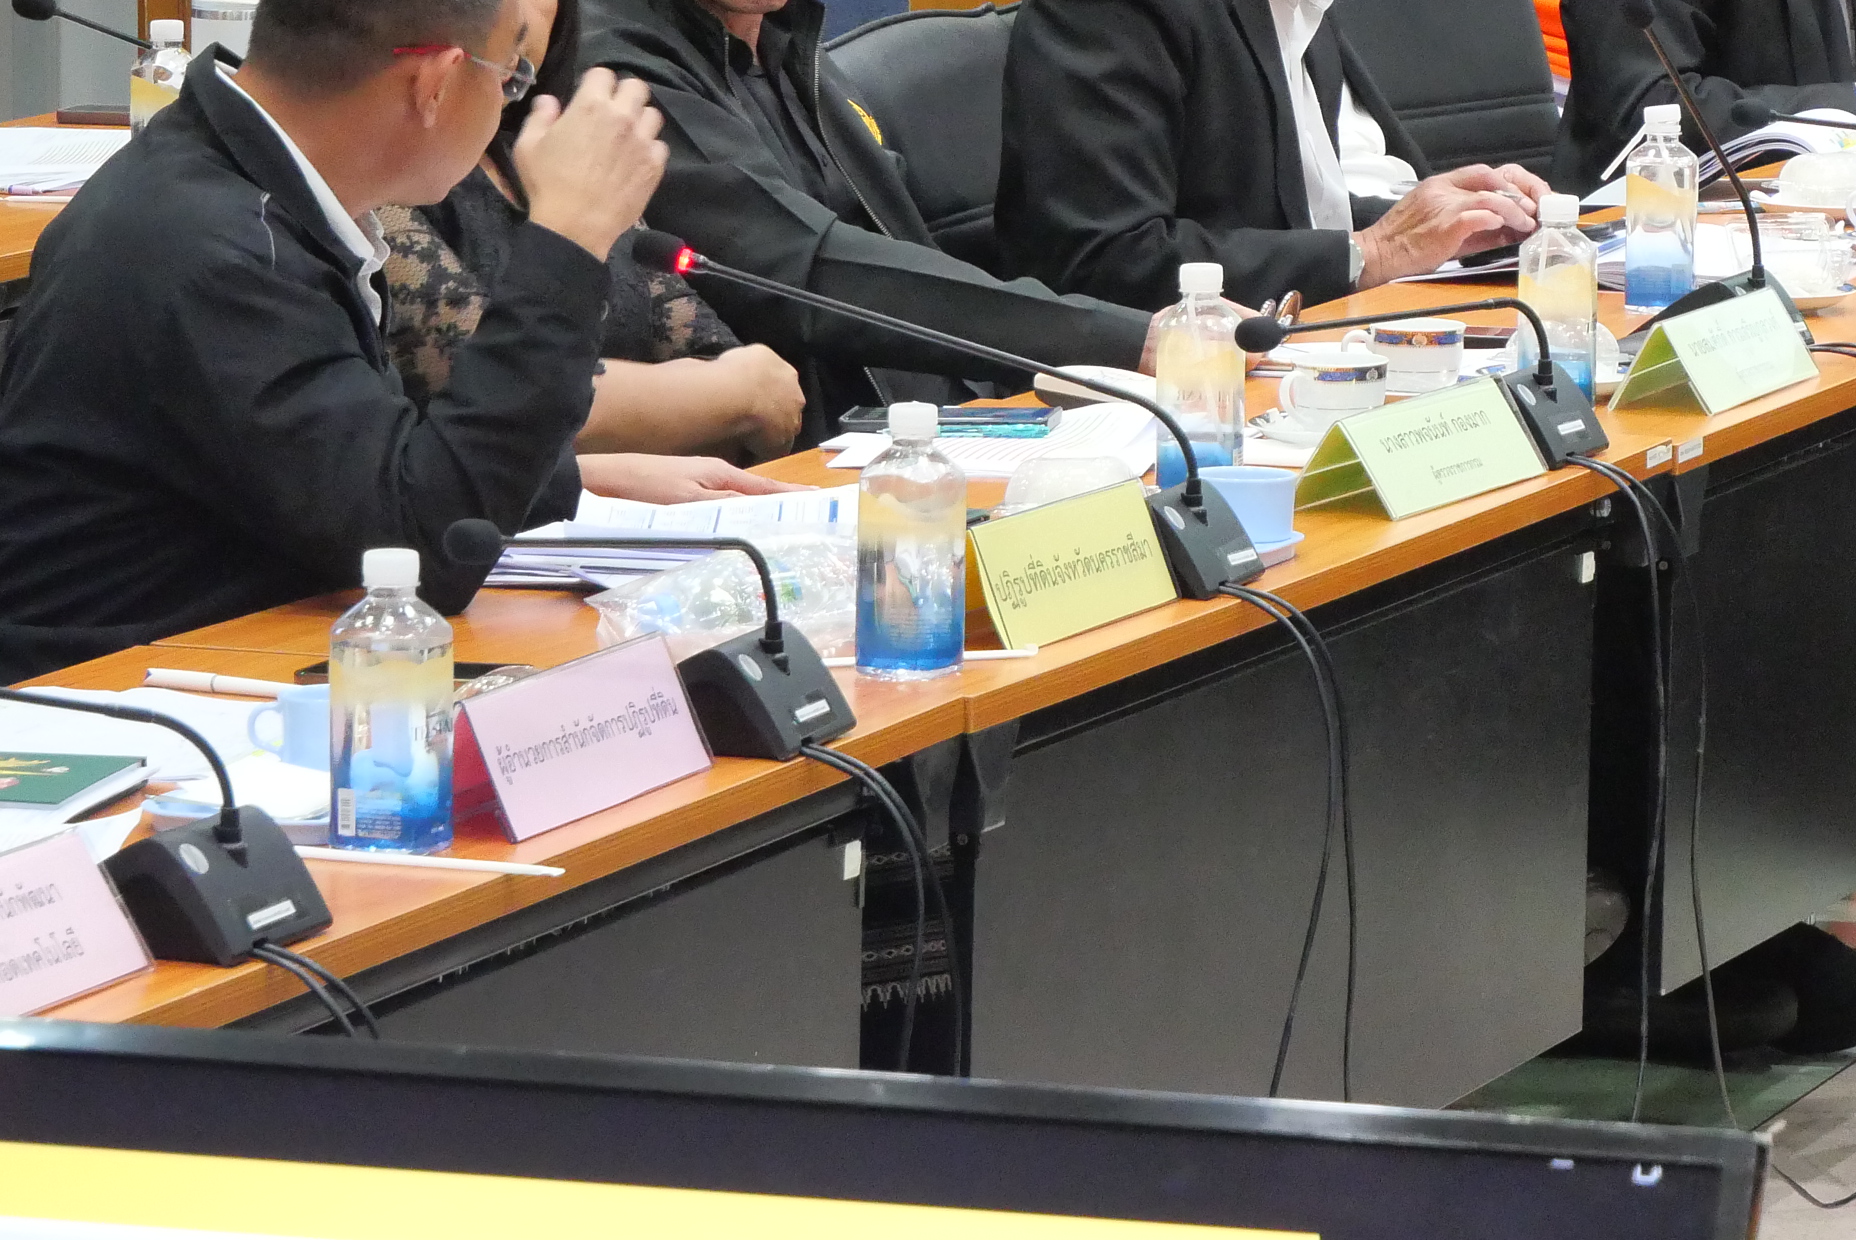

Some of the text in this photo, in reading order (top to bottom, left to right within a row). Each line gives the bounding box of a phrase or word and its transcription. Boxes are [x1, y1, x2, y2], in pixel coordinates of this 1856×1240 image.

[995, 532, 1154, 610] ปฏิรูปที่ดินจังหวัดนครราชสีมา
